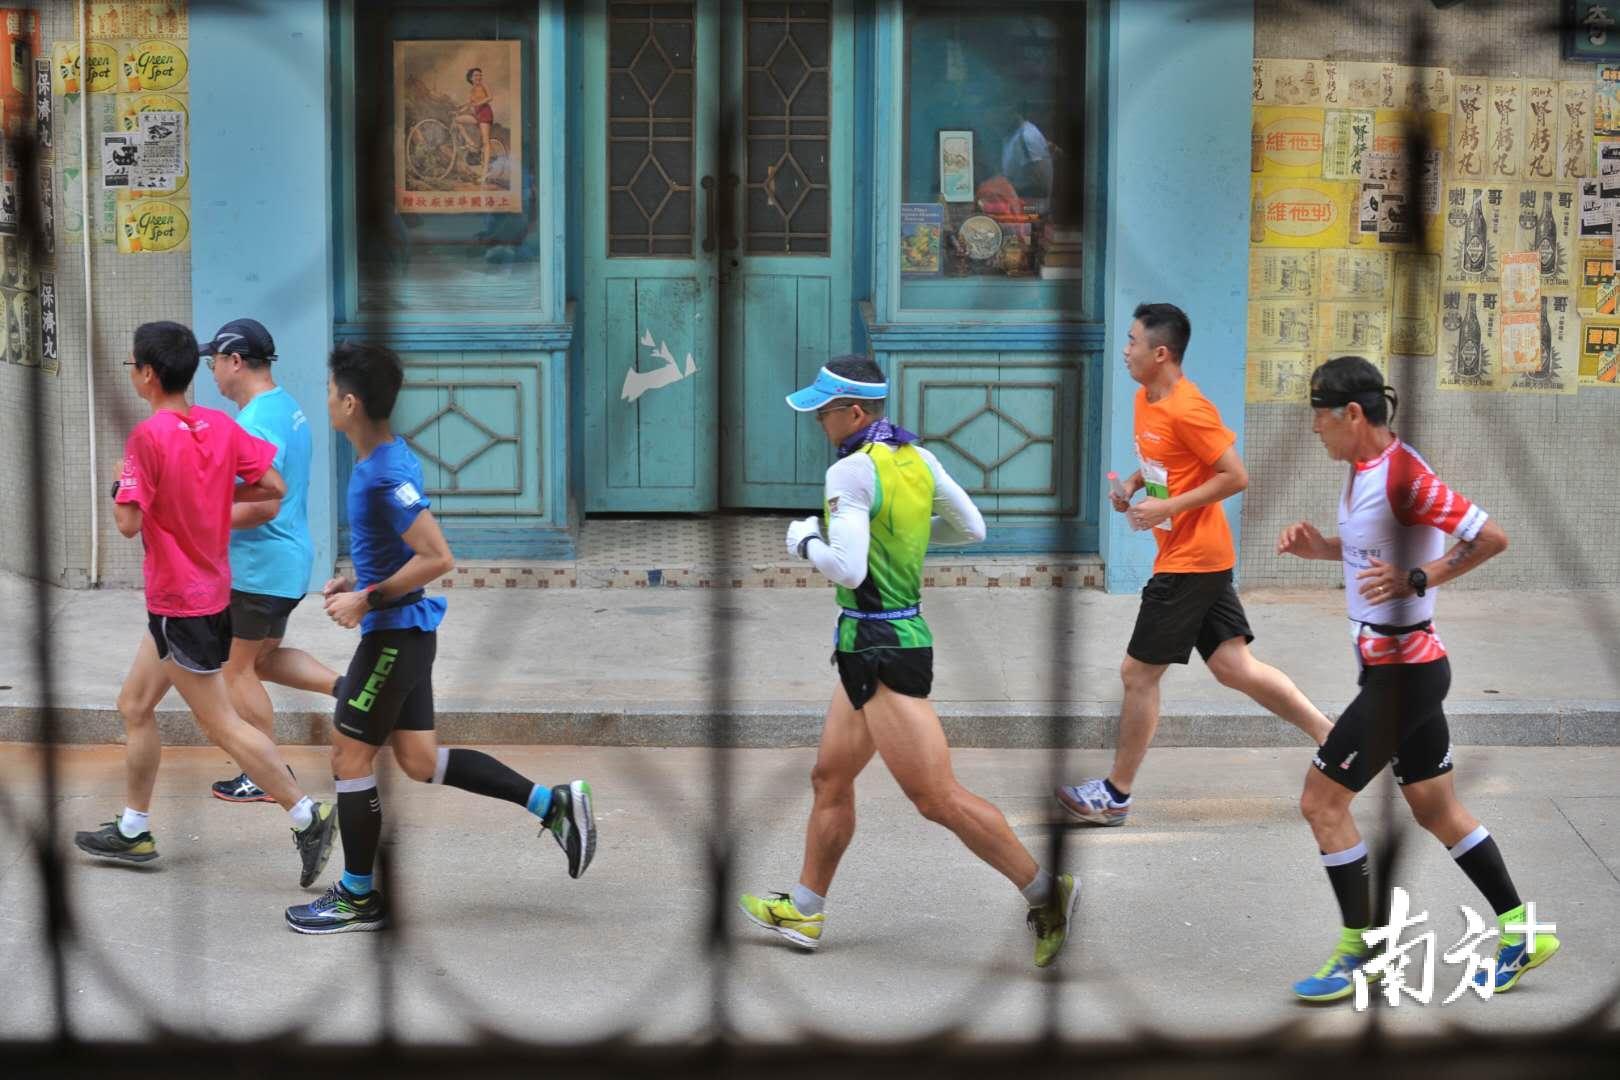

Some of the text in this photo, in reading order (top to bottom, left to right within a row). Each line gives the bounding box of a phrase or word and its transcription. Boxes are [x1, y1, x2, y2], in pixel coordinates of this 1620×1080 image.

[138, 51, 173, 74] Green
[148, 65, 174, 81] Spot
[1266, 199, 1333, 223] 維他奶
[139, 212, 174, 235] Green
[149, 226, 175, 242] Spot
[41, 286, 57, 359] 保濟丸
